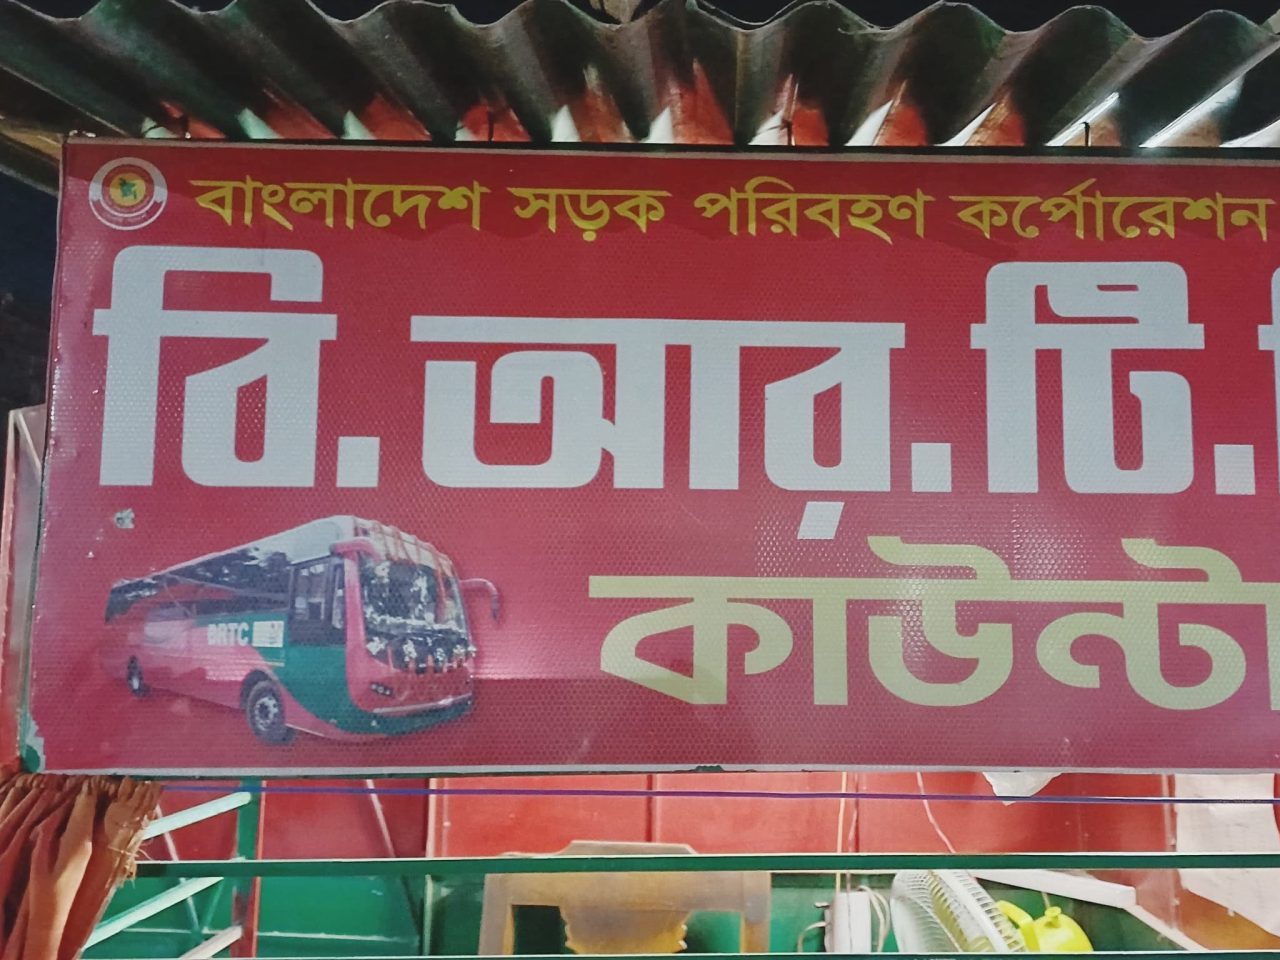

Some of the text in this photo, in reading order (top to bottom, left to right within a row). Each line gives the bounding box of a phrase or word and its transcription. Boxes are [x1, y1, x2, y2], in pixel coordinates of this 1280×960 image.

[190, 174, 491, 232] বাংলাদেশ
[506, 182, 672, 242] সড়ক
[949, 177, 1277, 242] কর্পোরেশন
